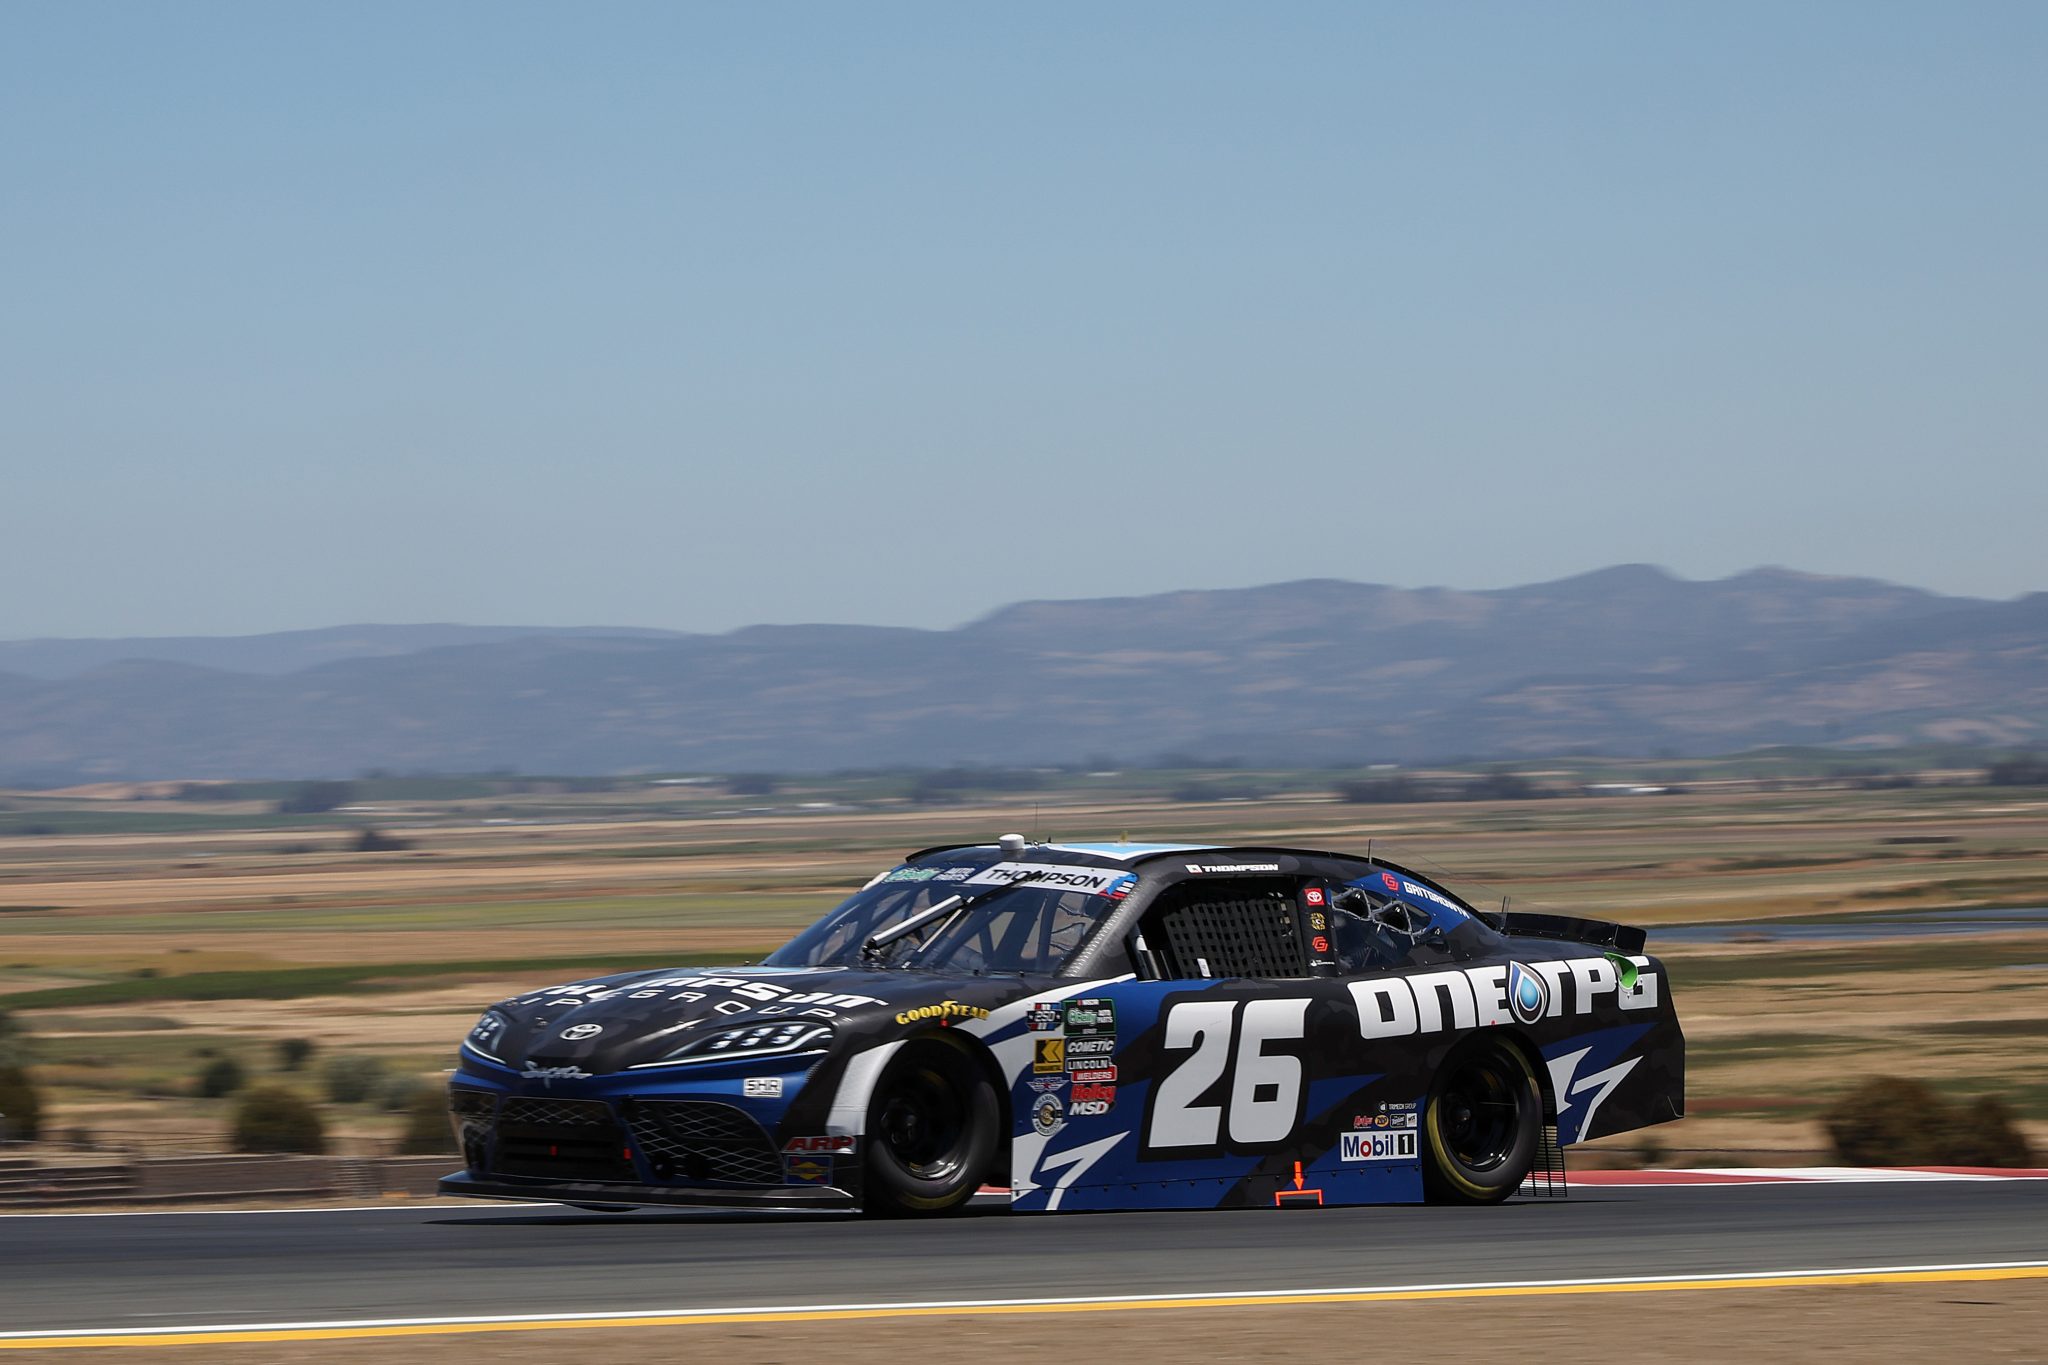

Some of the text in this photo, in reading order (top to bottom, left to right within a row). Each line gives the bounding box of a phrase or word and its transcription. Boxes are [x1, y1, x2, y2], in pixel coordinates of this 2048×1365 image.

[1202, 864, 1279, 873] THOMPSON
[986, 869, 1107, 889] THOMPSON
[1346, 965, 1516, 1040] ONE
[895, 1000, 991, 1025] GOODYEAR
[1033, 1010, 1056, 1022] 250
[1067, 1040, 1115, 1053] COMETIC
[1068, 1059, 1108, 1070] LINCOLN
[1148, 997, 1314, 1148] 26
[1076, 1071, 1112, 1080] WELDERS
[1071, 1083, 1117, 1105] Holley
[1068, 1101, 1110, 1116] MSD
[783, 1136, 858, 1152] ARP
[1343, 1133, 1410, 1158] Mobil 1
